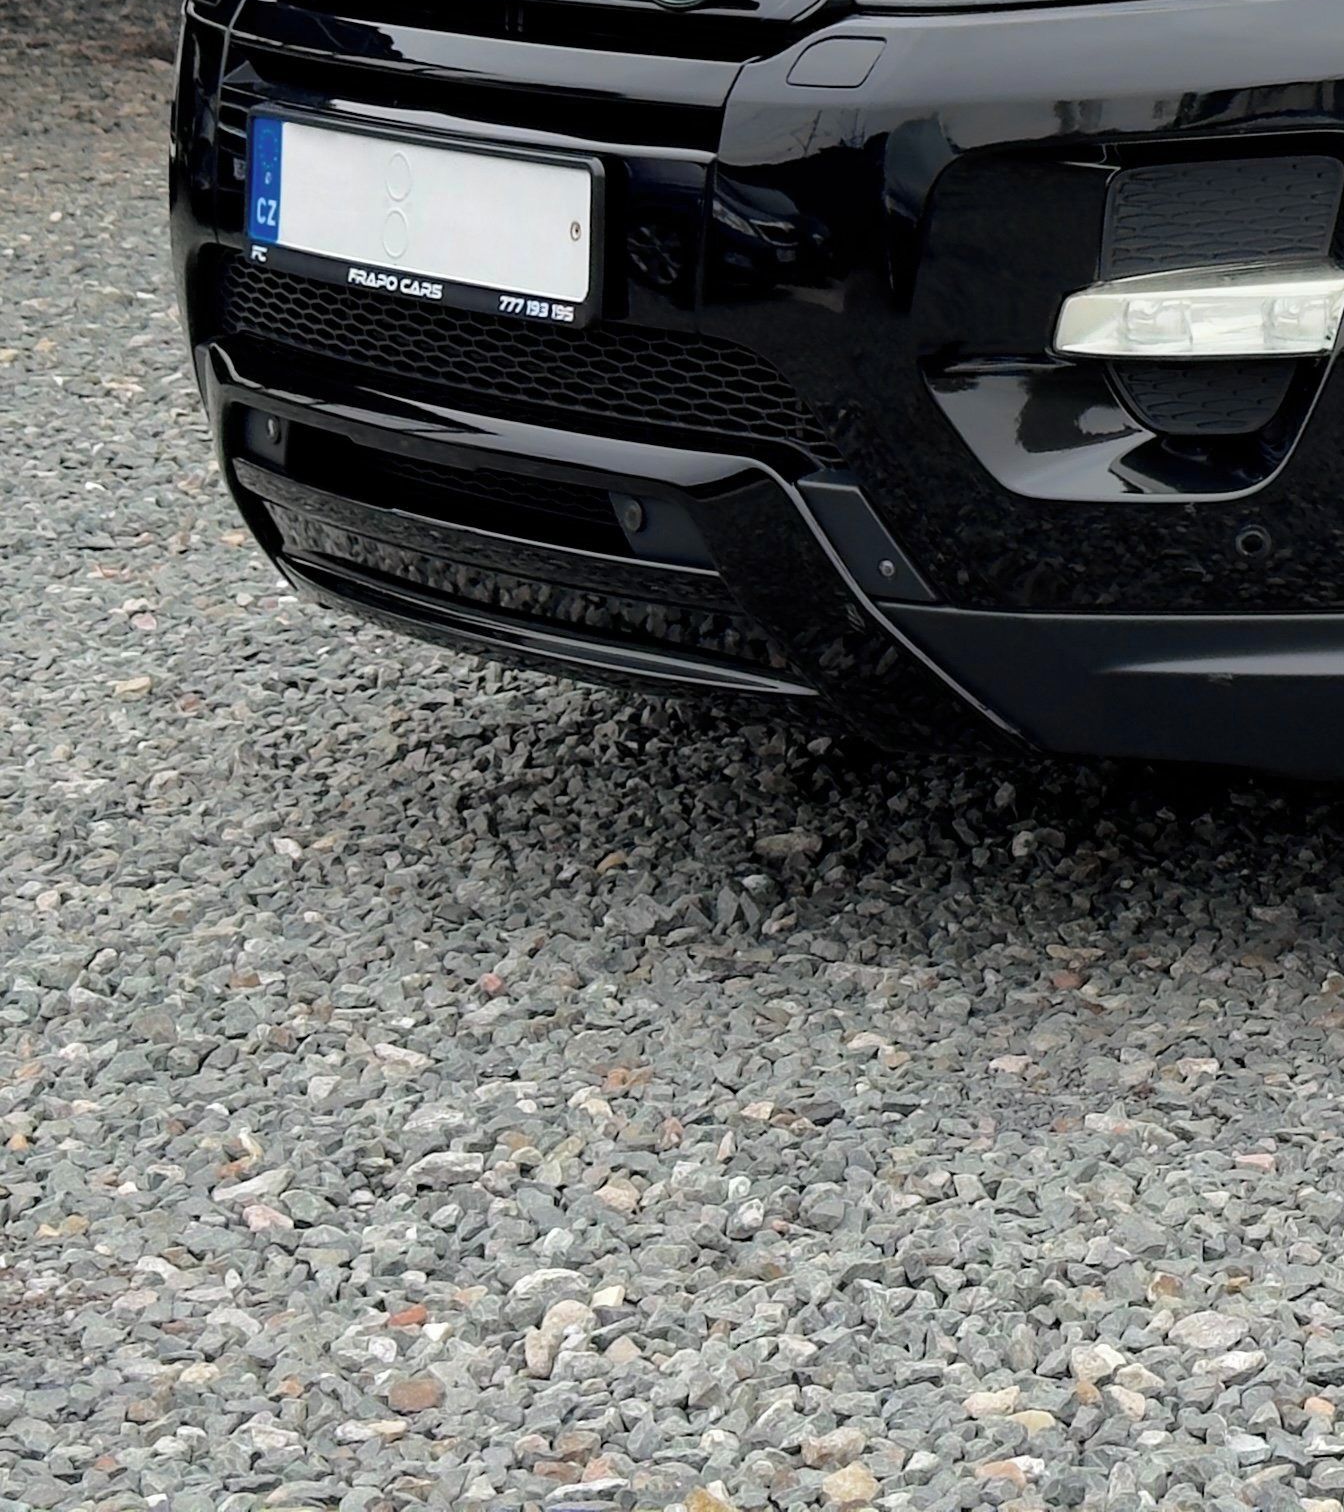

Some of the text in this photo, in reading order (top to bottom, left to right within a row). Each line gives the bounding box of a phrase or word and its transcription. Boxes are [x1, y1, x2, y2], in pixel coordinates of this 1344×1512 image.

[256, 197, 278, 227] CZ
[348, 267, 444, 300] FRAPO CARS
[499, 294, 525, 314] 777
[526, 300, 550, 319] 193
